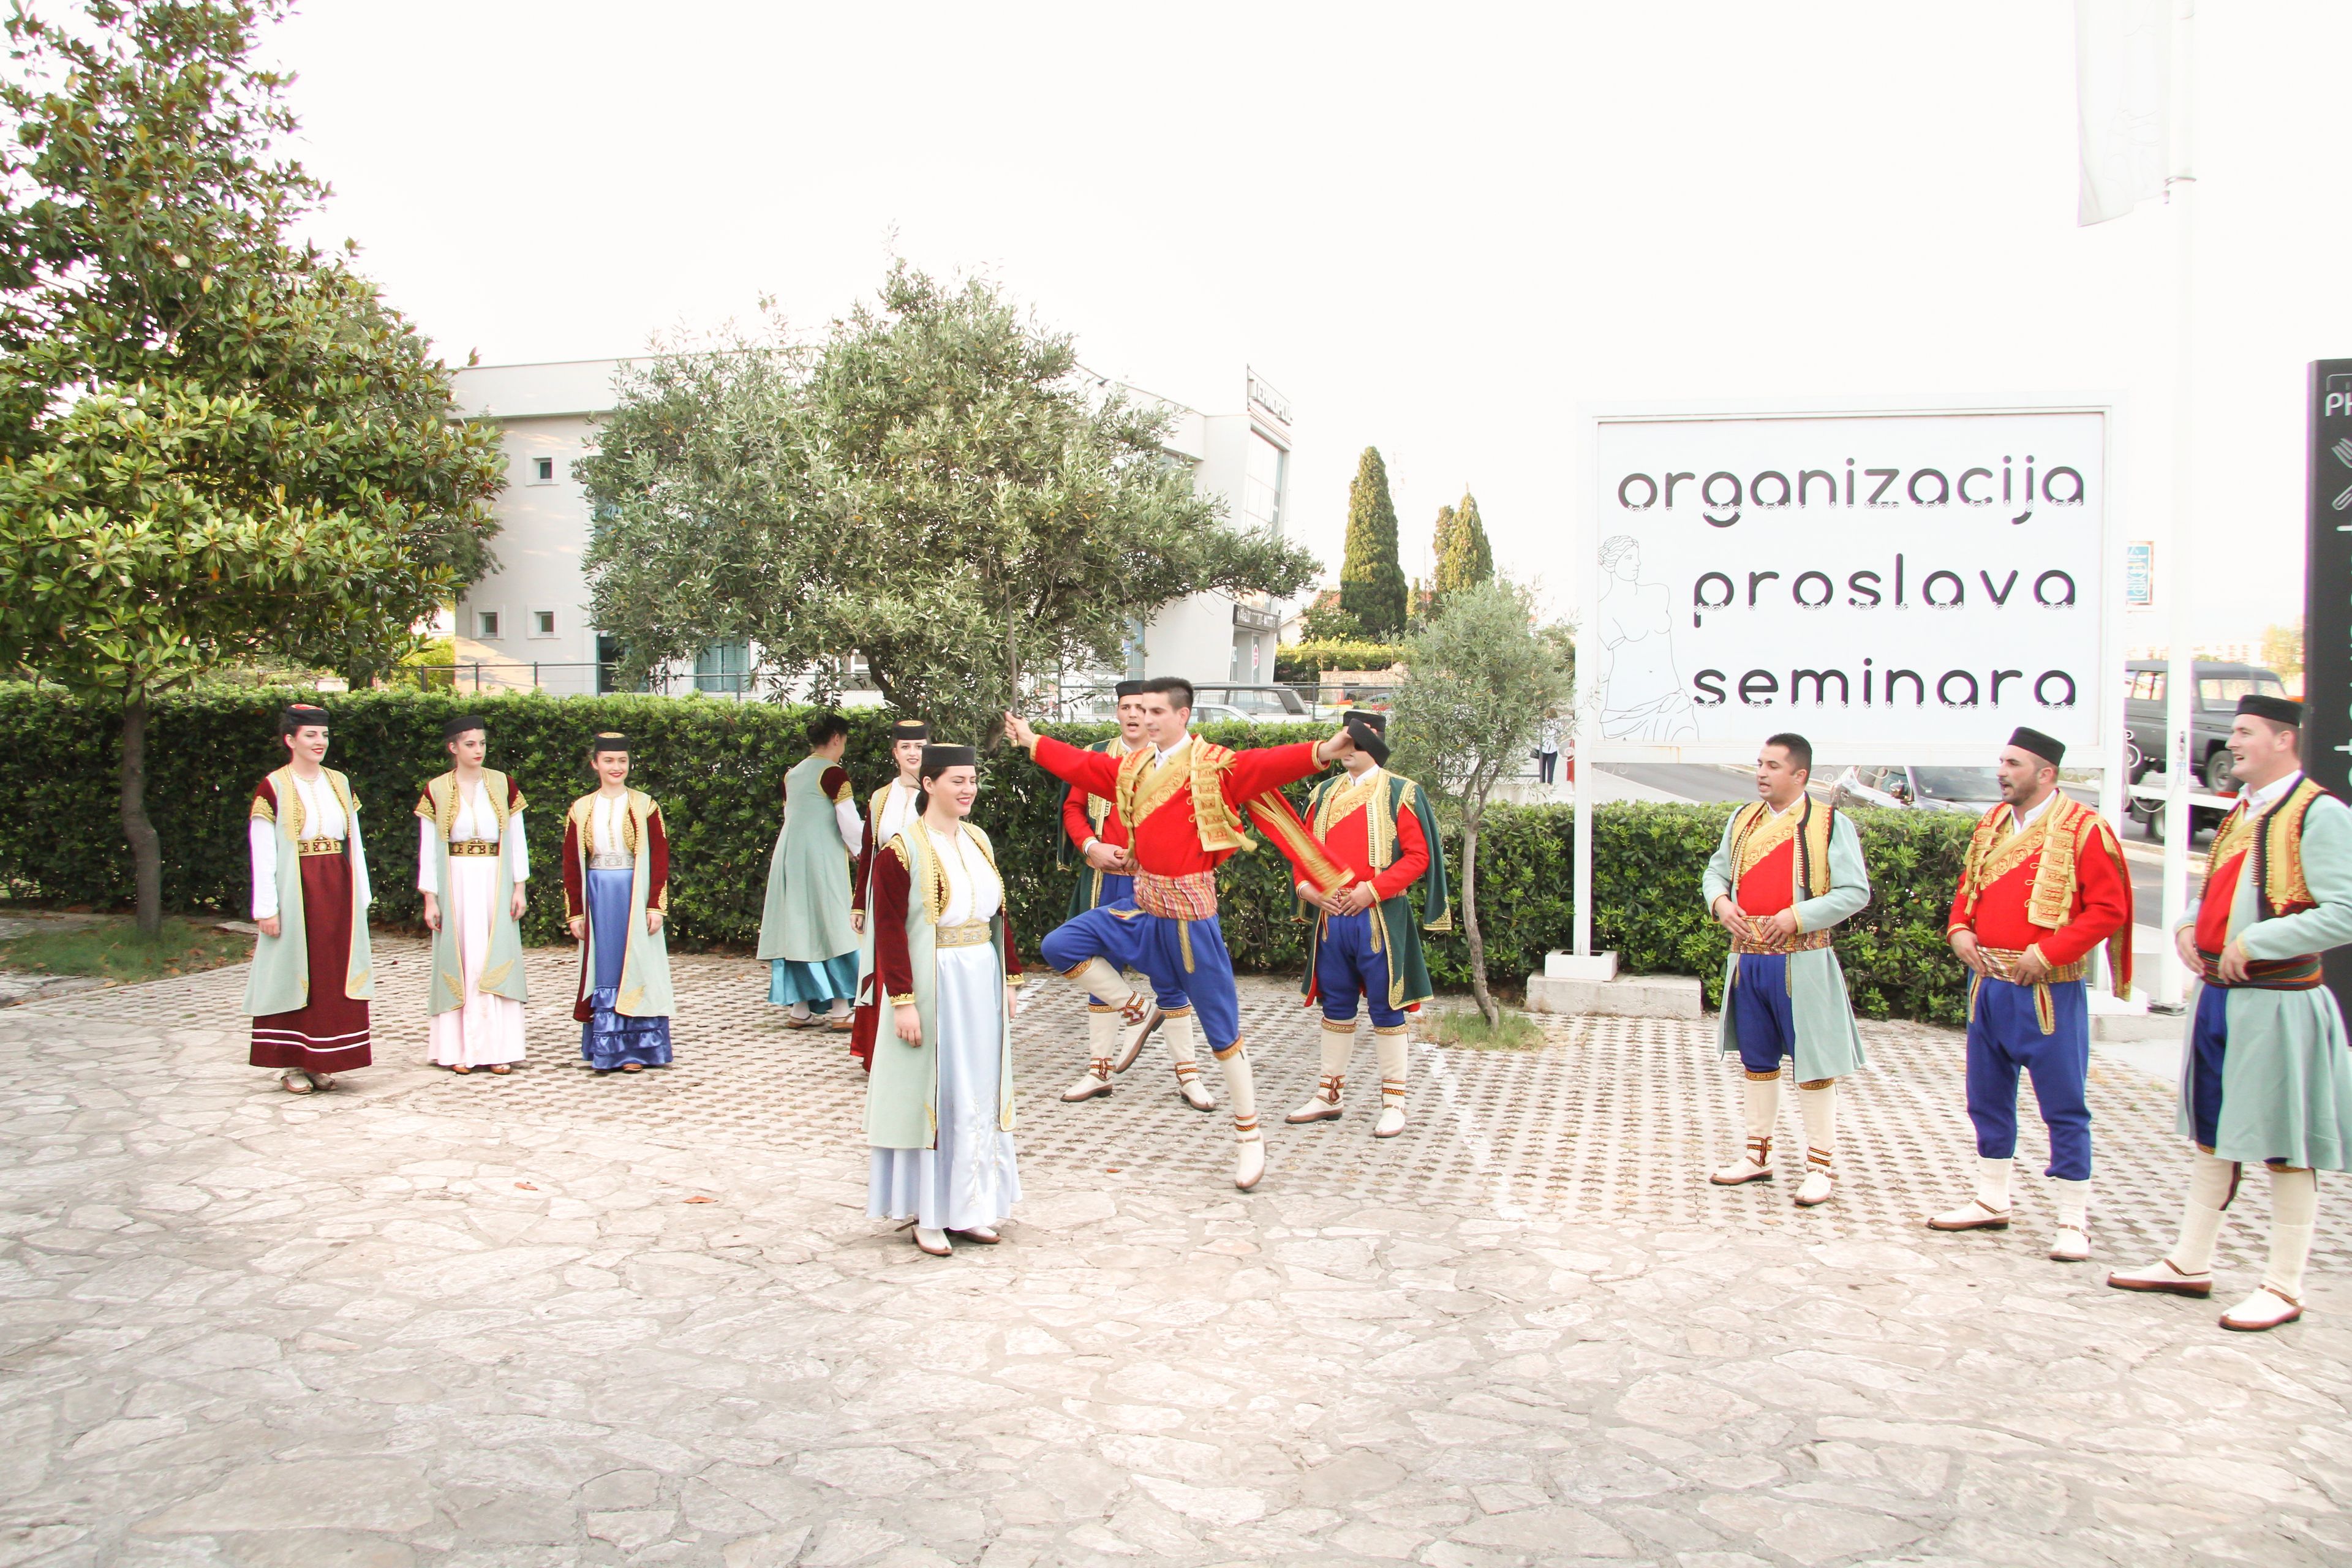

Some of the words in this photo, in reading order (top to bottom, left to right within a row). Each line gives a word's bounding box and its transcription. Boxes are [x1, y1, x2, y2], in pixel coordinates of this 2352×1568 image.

[1618, 454, 2084, 528] organizacija
[1694, 552, 2075, 628] proslava
[1693, 657, 2076, 710] seminara
